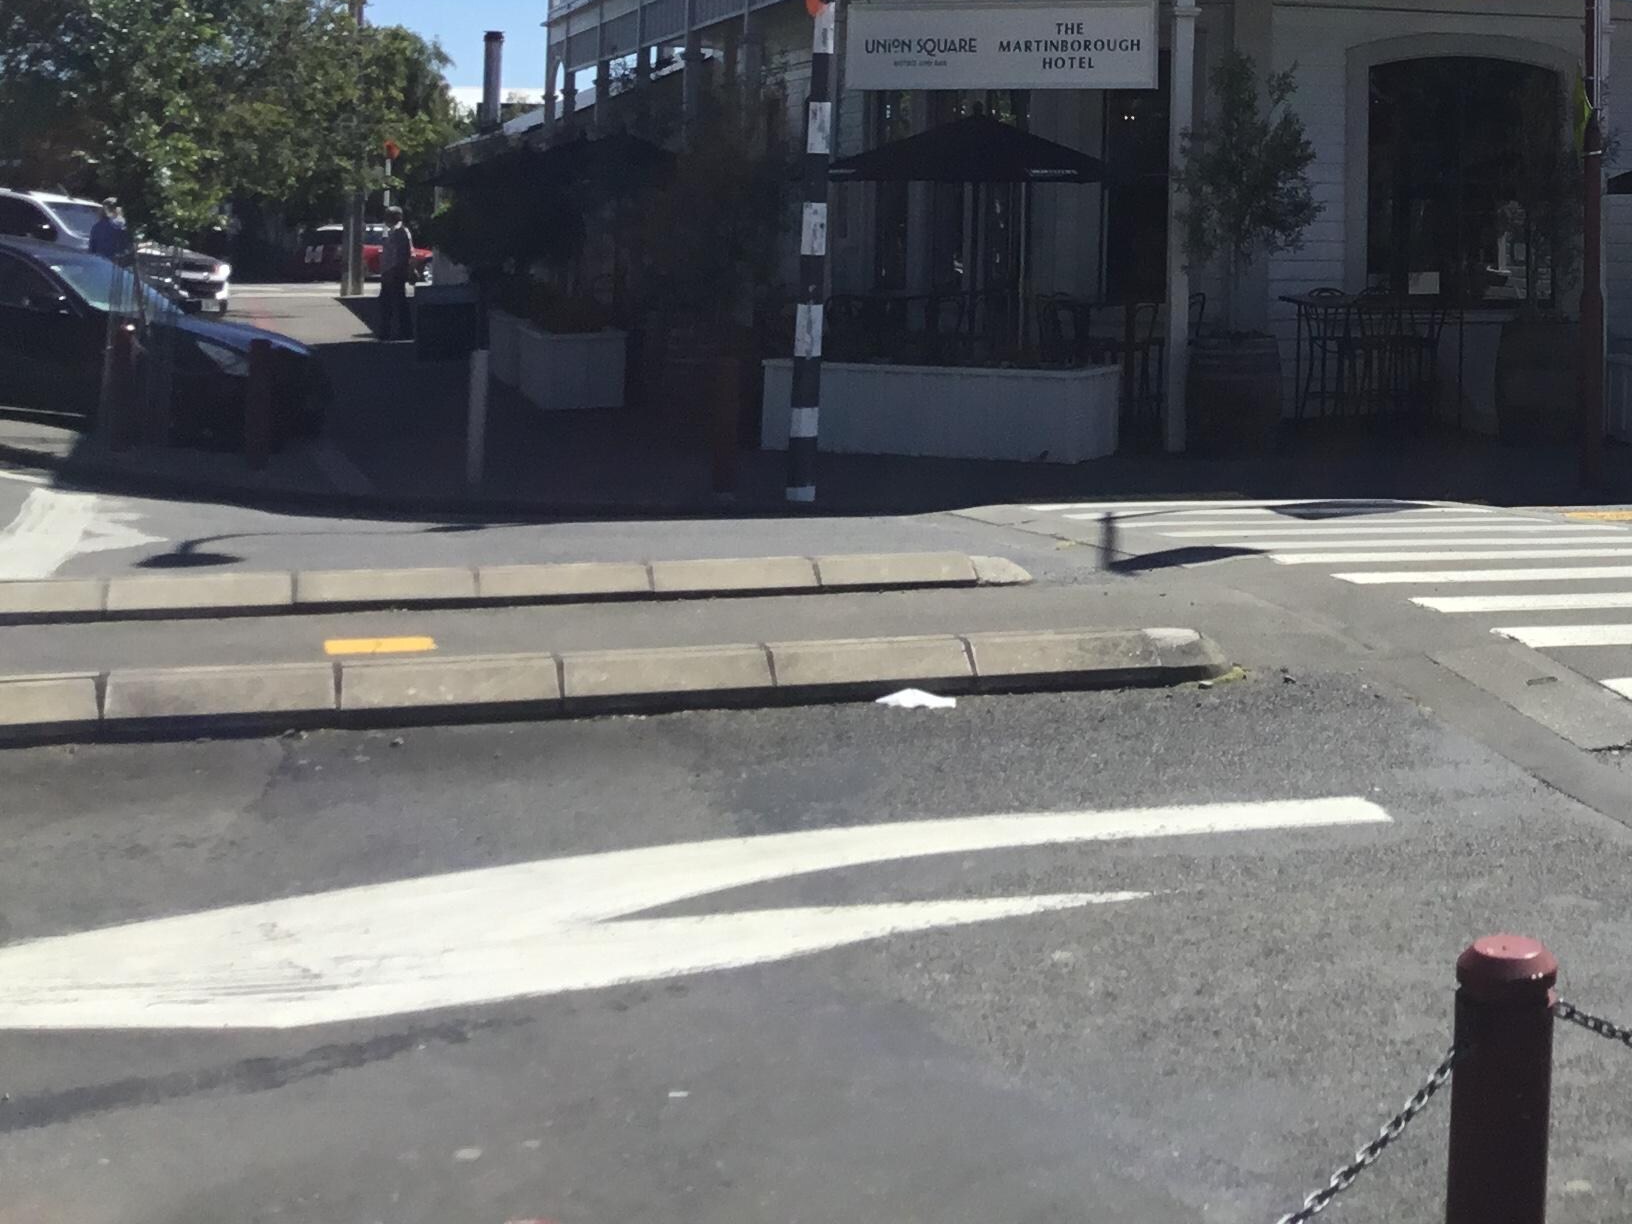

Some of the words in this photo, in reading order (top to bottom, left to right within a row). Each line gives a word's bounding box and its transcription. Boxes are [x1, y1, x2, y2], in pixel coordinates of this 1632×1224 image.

[1056, 23, 1084, 35] THE
[917, 38, 977, 57] SQUARE
[999, 39, 1141, 53] MARTINBOROUGH
[1042, 57, 1095, 70] HOTEL
